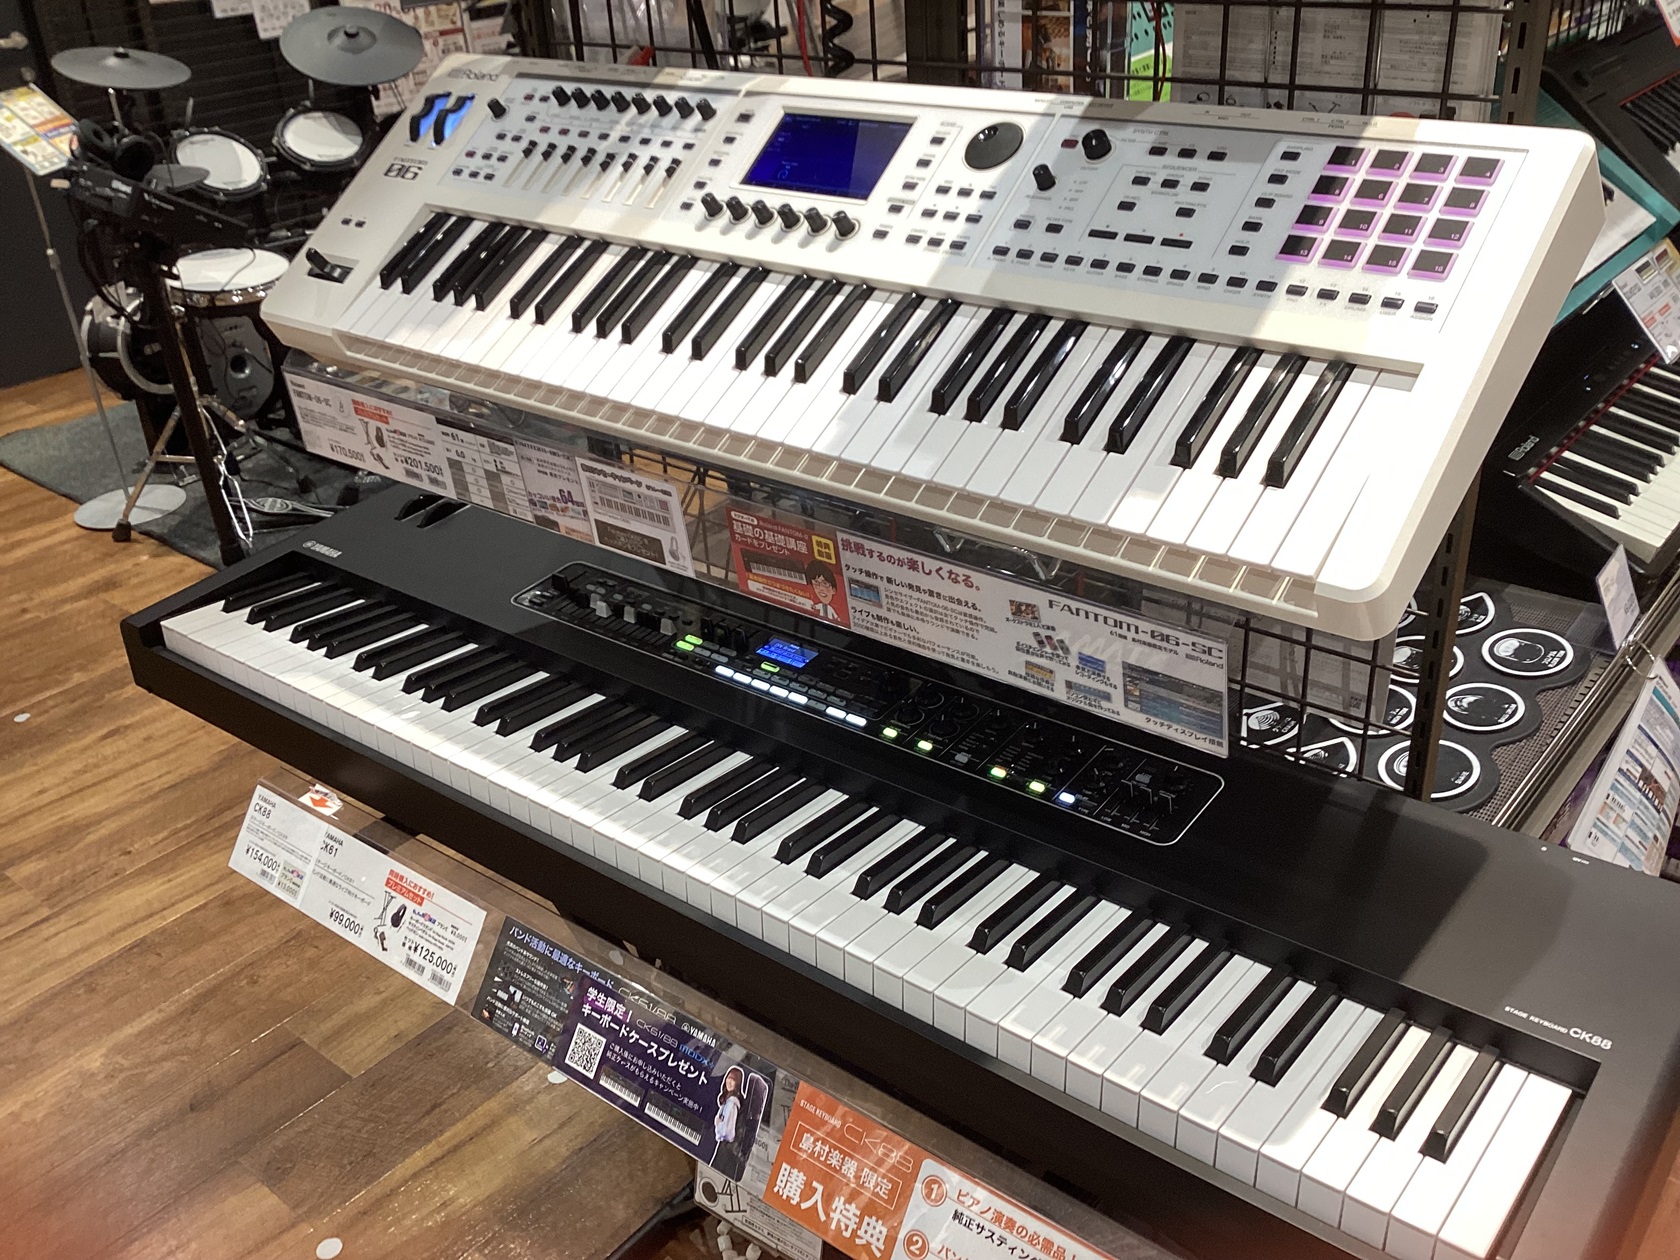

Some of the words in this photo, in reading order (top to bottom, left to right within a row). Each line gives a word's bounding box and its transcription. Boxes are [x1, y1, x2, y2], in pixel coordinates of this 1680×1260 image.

[460, 69, 500, 82] Roland
[449, 431, 460, 442] 61
[732, 519, 808, 554] 基礎の基礎講座
[734, 532, 790, 557] カードをプレゼント
[840, 535, 981, 594] 挑戦するのが楽しくなる。
[844, 562, 884, 583] タッチ操作で
[850, 604, 919, 636] ライブも制作も楽しい。
[1048, 599, 1223, 660] FANTOM-06-SC
[1197, 656, 1223, 670] Roland
[1145, 716, 1223, 748] タッチディスプレイ搭載
[252, 801, 272, 820] CK88
[256, 793, 277, 809] YAMAHA
[244, 843, 278, 872] ¥154,000
[385, 878, 423, 905] プレミアムセット
[327, 907, 361, 936] ¥99,000
[411, 941, 454, 976] ¥125,000
[508, 924, 614, 991] バンド活動に最適なキーボード
[635, 1016, 679, 1049] CK61/88
[689, 1026, 717, 1048] YAMAHA
[1504, 1005, 1528, 1019] STAGE
[1528, 1014, 1568, 1034] KEYBOARD
[1569, 1027, 1613, 1050] CK88
[579, 999, 710, 1089] キーボードケースプレゼント
[608, 1041, 682, 1091] ご購入後にお申し込みいただくと
[799, 1098, 817, 1114] STAGE
[814, 1107, 841, 1128] KEYBOARD
[841, 1120, 915, 1174] CK88
[797, 1130, 860, 1179] 島村楽器
[858, 1167, 893, 1199] 限定
[772, 1162, 890, 1258] 購入特典
